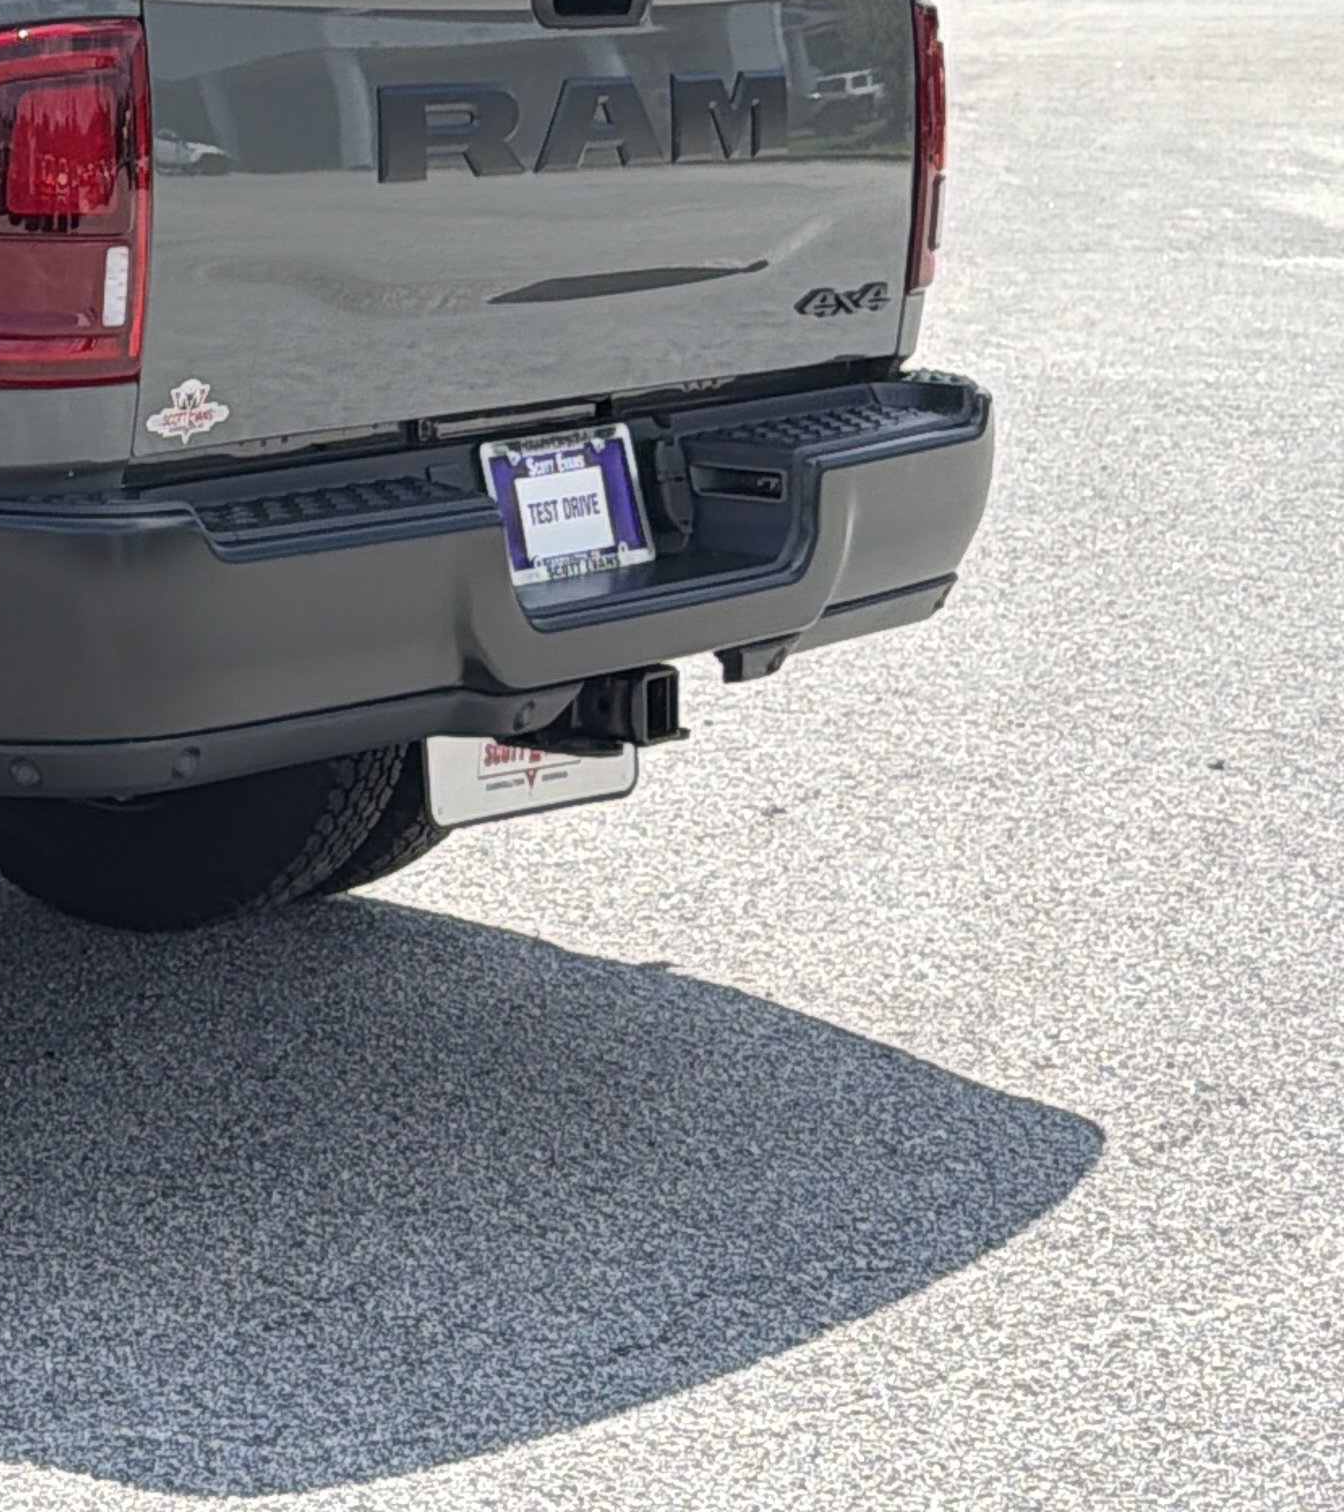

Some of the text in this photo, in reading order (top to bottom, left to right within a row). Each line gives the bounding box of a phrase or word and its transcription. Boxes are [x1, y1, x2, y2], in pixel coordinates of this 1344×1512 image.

[376, 70, 788, 183] RAM
[527, 492, 601, 526] TEST DRIVE
